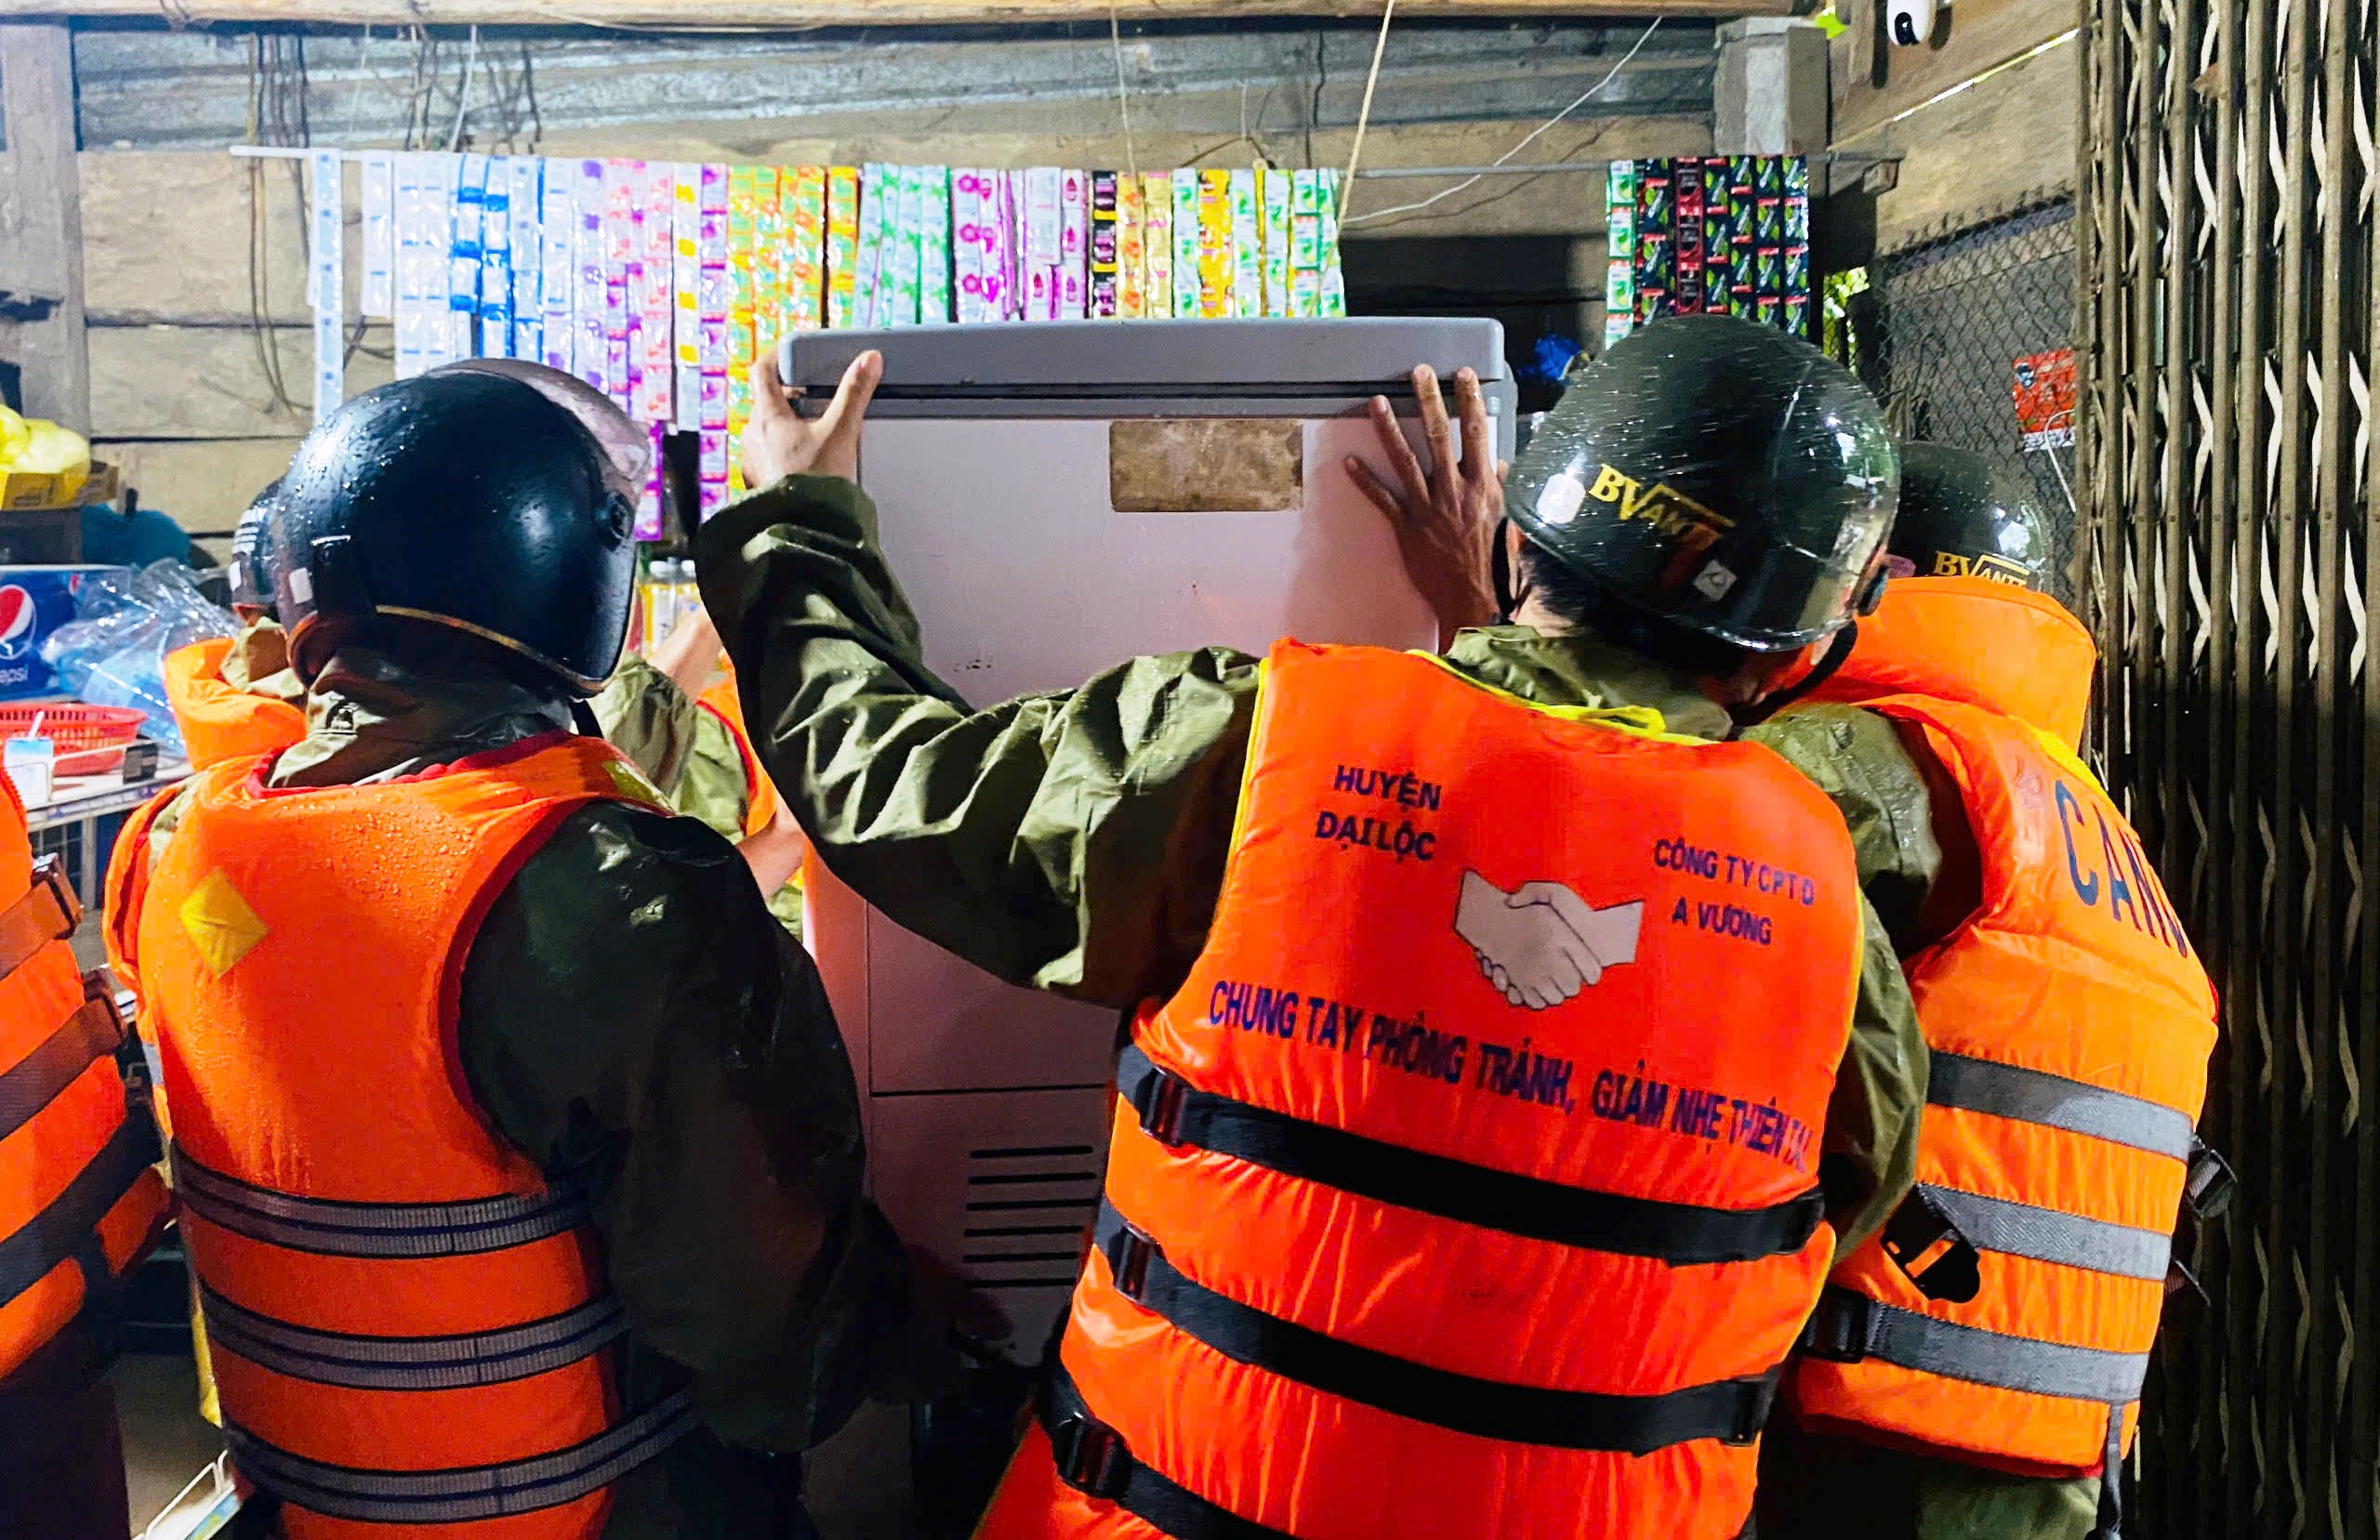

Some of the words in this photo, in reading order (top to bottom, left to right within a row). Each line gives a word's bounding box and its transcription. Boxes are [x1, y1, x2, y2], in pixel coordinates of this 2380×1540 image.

[1333, 764, 1442, 811] HUYỆN
[1376, 821, 1436, 862] LỘC
[1654, 836, 1718, 879] CÔNG
[1726, 855, 1755, 887] TY
[1672, 896, 1688, 926] A
[1210, 980, 1300, 1039] CHUNG
[1306, 996, 1364, 1053] TAY
[1671, 1086, 1727, 1154] NHẸ
